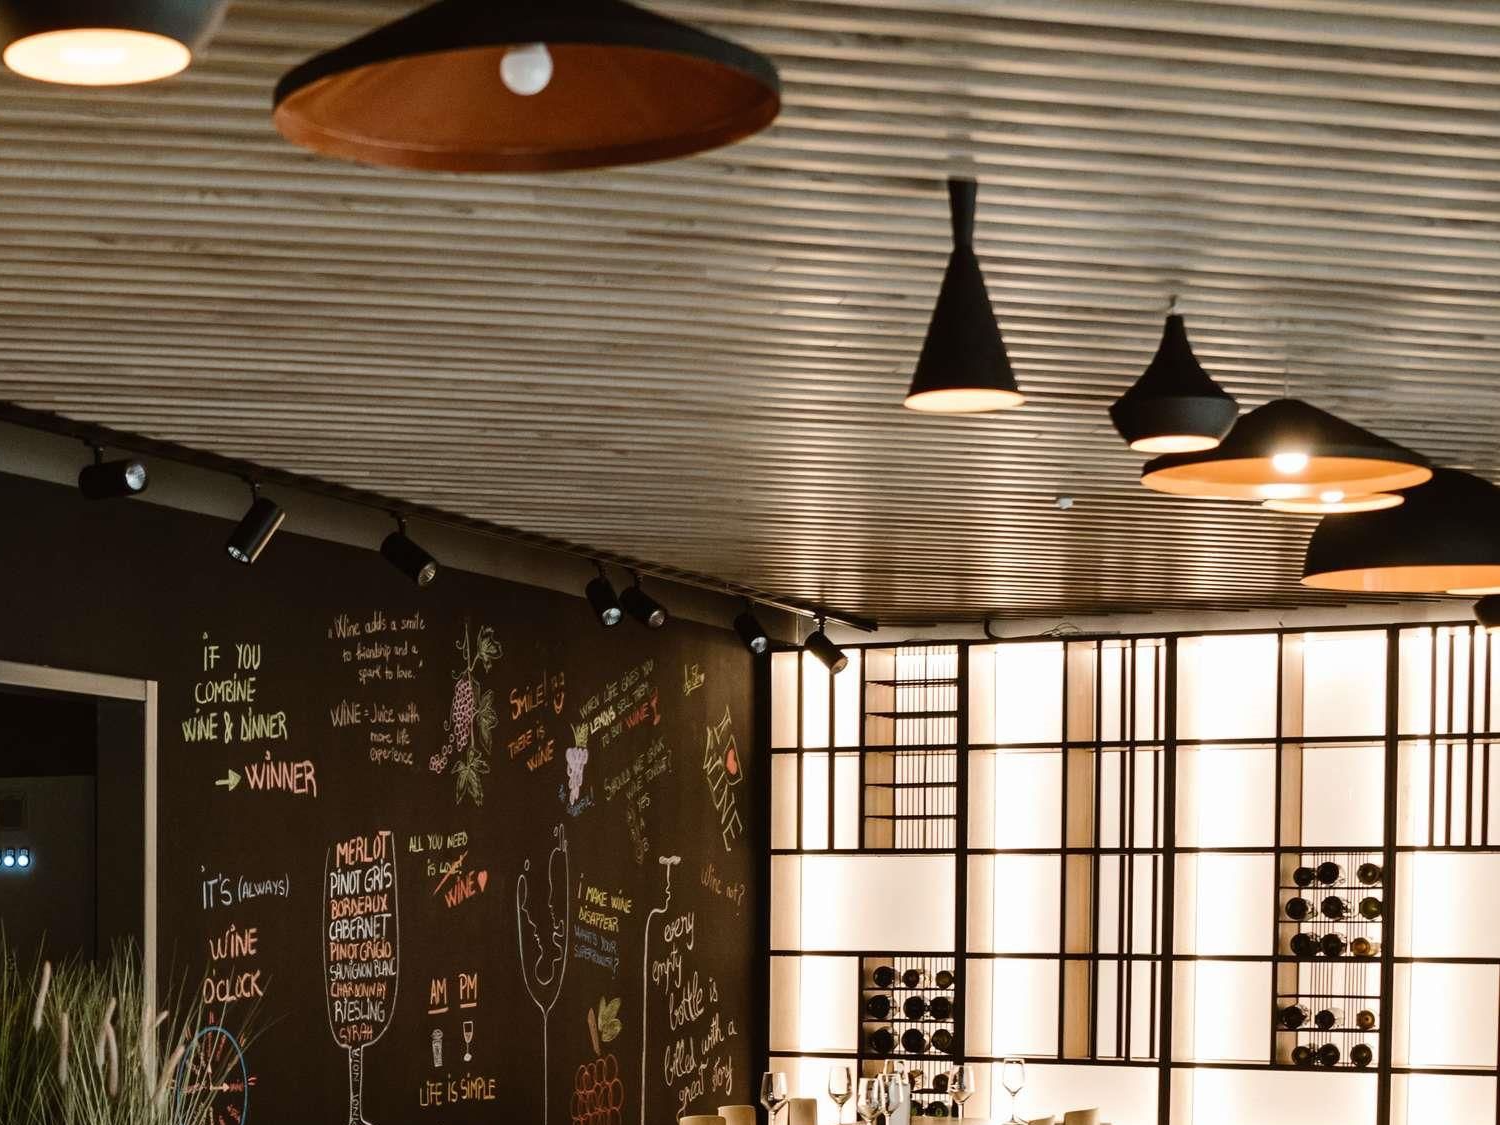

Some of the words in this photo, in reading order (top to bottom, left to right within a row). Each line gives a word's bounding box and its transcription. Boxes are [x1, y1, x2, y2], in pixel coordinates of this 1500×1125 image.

[364, 609, 387, 633] adds
[390, 619, 397, 631] a
[401, 609, 426, 630] smile
[236, 643, 261, 670] YOU
[342, 649, 352, 662] to
[394, 640, 409, 656] and
[411, 645, 419, 655] a
[195, 673, 256, 704] COMBINE
[358, 664, 382, 685] spark
[385, 664, 394, 680] to
[182, 708, 218, 742] WINE
[223, 711, 234, 744] &
[240, 706, 288, 743] DINNER
[330, 699, 361, 727] WINE
[398, 702, 420, 723] with
[370, 731, 393, 744] more
[396, 727, 410, 745] life
[369, 746, 414, 766] experience
[526, 739, 556, 772] WINE
[244, 750, 317, 798] WINNER
[336, 828, 392, 868] MERLOT
[409, 835, 424, 853] ALL
[427, 833, 443, 850] YOU
[447, 831, 468, 849] NEED
[200, 865, 233, 910] IT'S
[238, 873, 290, 902] (ALWAYS)
[329, 868, 362, 898] PINOT
[364, 858, 393, 893] GRIS
[445, 870, 476, 909] WINE
[331, 893, 389, 920] BORDEAUX
[585, 886, 608, 907] MAKE
[611, 889, 632, 914] WINE
[329, 913, 392, 941] CABERNET
[579, 905, 619, 933] DISAPPEAR
[664, 911, 695, 950] every
[209, 923, 257, 960] WINE
[329, 938, 360, 961] PINOT
[360, 938, 392, 961] GRIGIO
[329, 960, 373, 982] SAUVIGNON
[373, 957, 397, 979] BLANC
[652, 943, 682, 995] empty
[330, 981, 388, 1000] CHARDONNAY
[429, 977, 448, 1006] AM
[458, 973, 478, 1001] PM
[669, 970, 705, 1031] bottle
[708, 976, 719, 1003] is
[334, 997, 386, 1023] RIESLING
[339, 1022, 373, 1044] SYRAH
[701, 1012, 725, 1055] with
[727, 1018, 739, 1036] a
